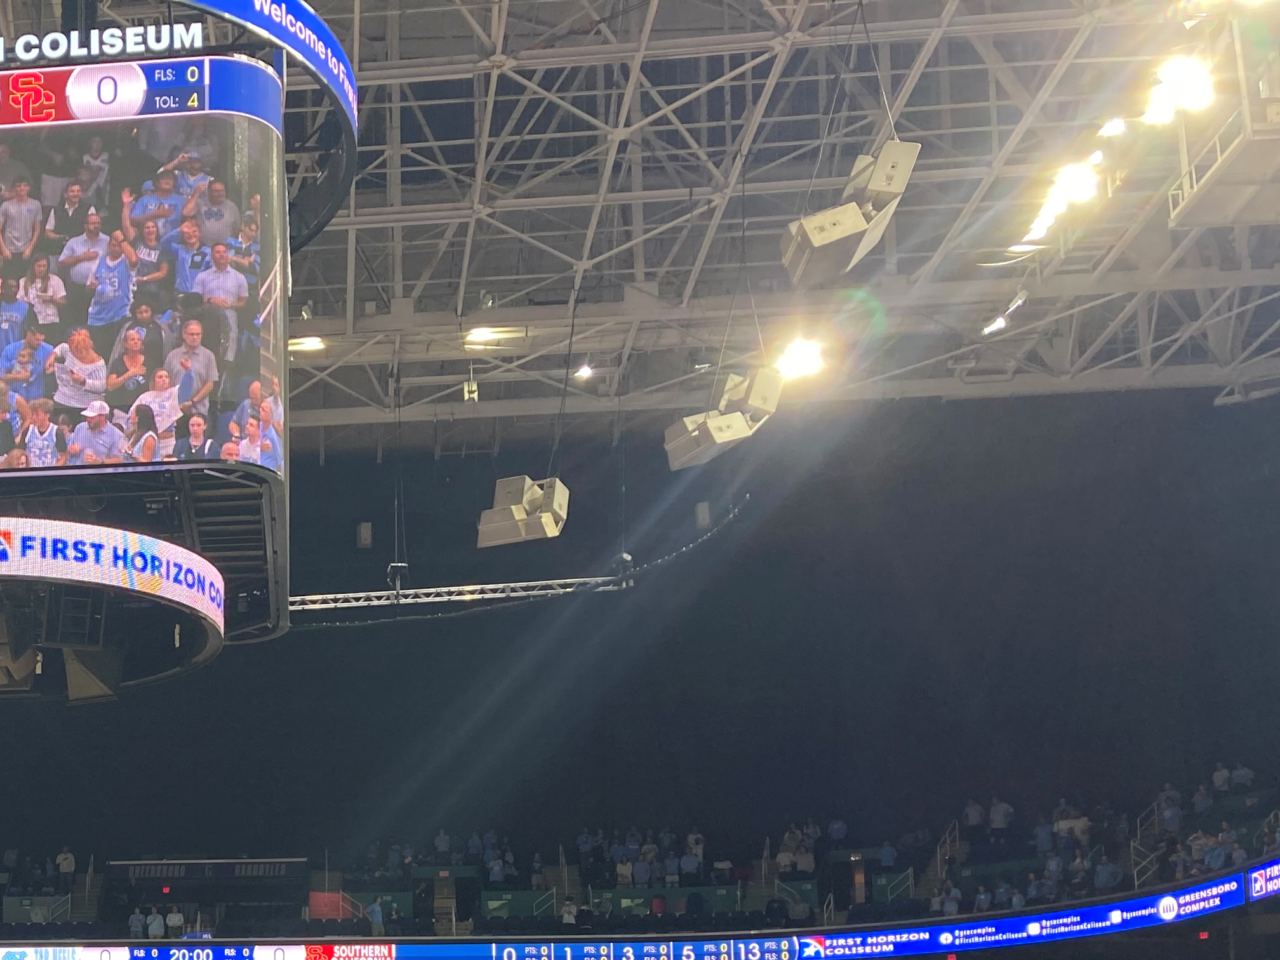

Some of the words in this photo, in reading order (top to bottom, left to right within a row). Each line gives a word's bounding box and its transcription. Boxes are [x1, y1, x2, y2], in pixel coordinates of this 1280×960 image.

[15, 22, 203, 61] COLISEUM
[253, 0, 326, 58] Welcome
[326, 47, 340, 75] to
[155, 69, 176, 82] FLS:
[187, 66, 199, 80] 0
[97, 76, 118, 105] 0
[155, 96, 179, 108] TOL:
[187, 92, 199, 108] 4
[21, 535, 105, 567] FIRST
[112, 541, 208, 595] HORIZON
[1179, 881, 1238, 904] GREENSBORO
[1179, 897, 1221, 915] COMPLEX
[825, 937, 862, 947] FIRST
[867, 932, 929, 943] HORIZON
[333, 945, 389, 957] SOUTHERN
[738, 943, 761, 960] 13
[825, 944, 894, 956] COLISEUM
